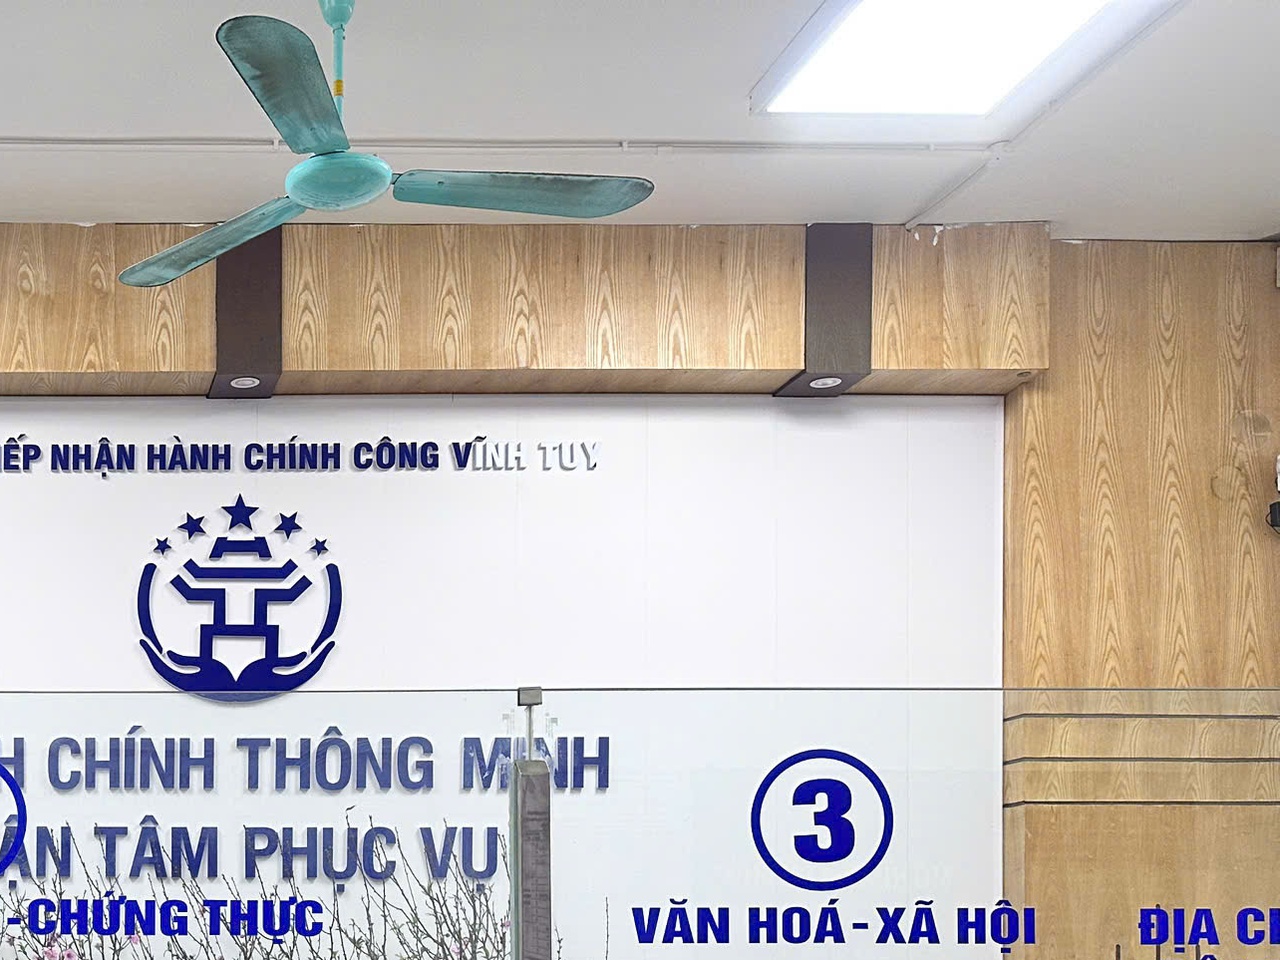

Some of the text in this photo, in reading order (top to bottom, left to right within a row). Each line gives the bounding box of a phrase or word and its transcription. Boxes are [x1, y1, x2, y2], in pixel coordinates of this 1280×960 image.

[50, 437, 136, 479] NHẬN
[147, 435, 232, 472] HÀNH
[243, 435, 342, 471] CHÍNH
[353, 436, 440, 471] CÔNG
[452, 435, 527, 471] VĨNH
[47, 725, 215, 790] CHÍNH
[236, 726, 434, 791] THÔNG
[792, 778, 856, 864] 3
[94, 815, 219, 880] TÂM
[243, 826, 397, 894] PHỤC
[420, 826, 499, 894] VỤ
[203, 896, 324, 945] THỰC
[631, 898, 730, 944] VĂN
[957, 899, 1036, 954] HỘI
[1137, 907, 1220, 954] ĐỊA
